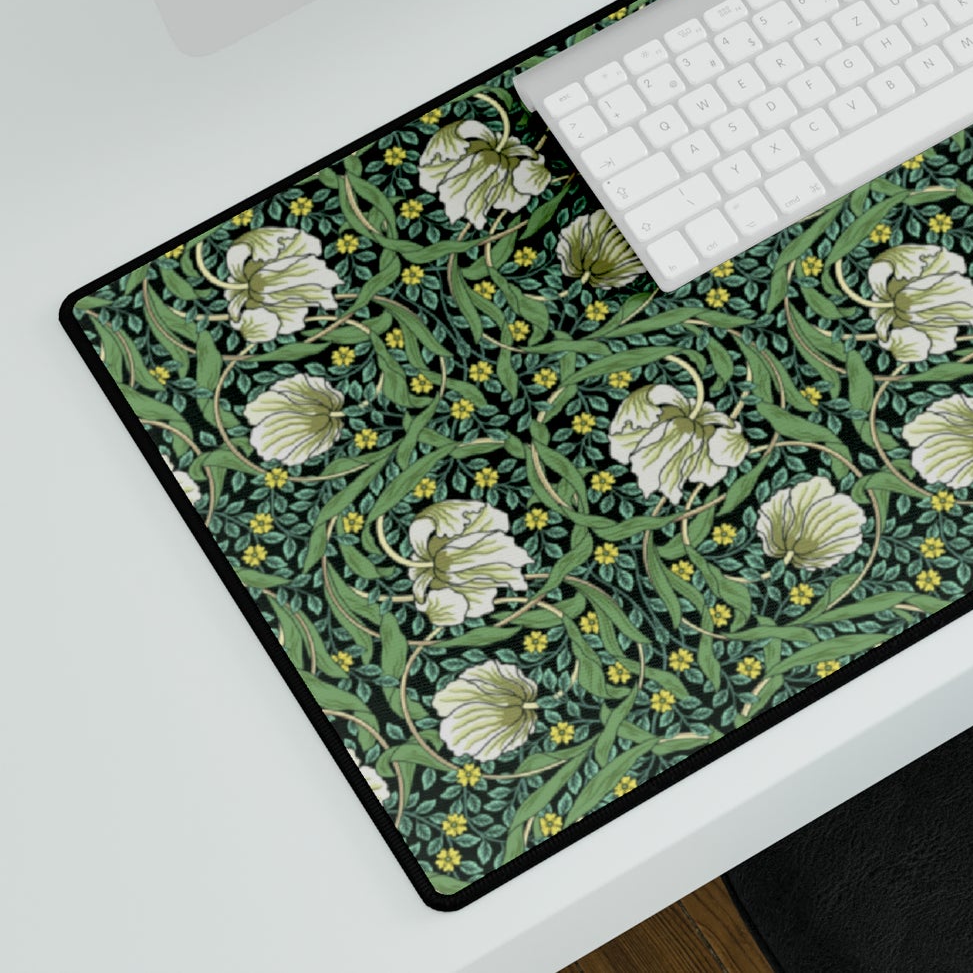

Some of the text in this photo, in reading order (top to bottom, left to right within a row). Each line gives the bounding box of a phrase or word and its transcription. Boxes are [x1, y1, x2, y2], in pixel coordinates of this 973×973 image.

[760, 16, 767, 25] 5
[852, 16, 862, 26] Z
[881, 38, 892, 48] H
[961, 37, 973, 48] M
[682, 58, 691, 67] 3
[776, 59, 785, 67] R
[843, 59, 853, 68] G
[923, 59, 934, 68] N
[644, 79, 652, 88] 2
[738, 79, 746, 89] E
[805, 80, 814, 90] F
[886, 80, 895, 89] B
[696, 99, 709, 110] W
[766, 101, 776, 111] D
[847, 100, 856, 110] V
[660, 122, 670, 131] Q
[728, 123, 737, 131] S
[809, 122, 819, 131] C
[690, 144, 699, 154] A
[769, 143, 781, 153] X
[731, 164, 739, 173] Y
